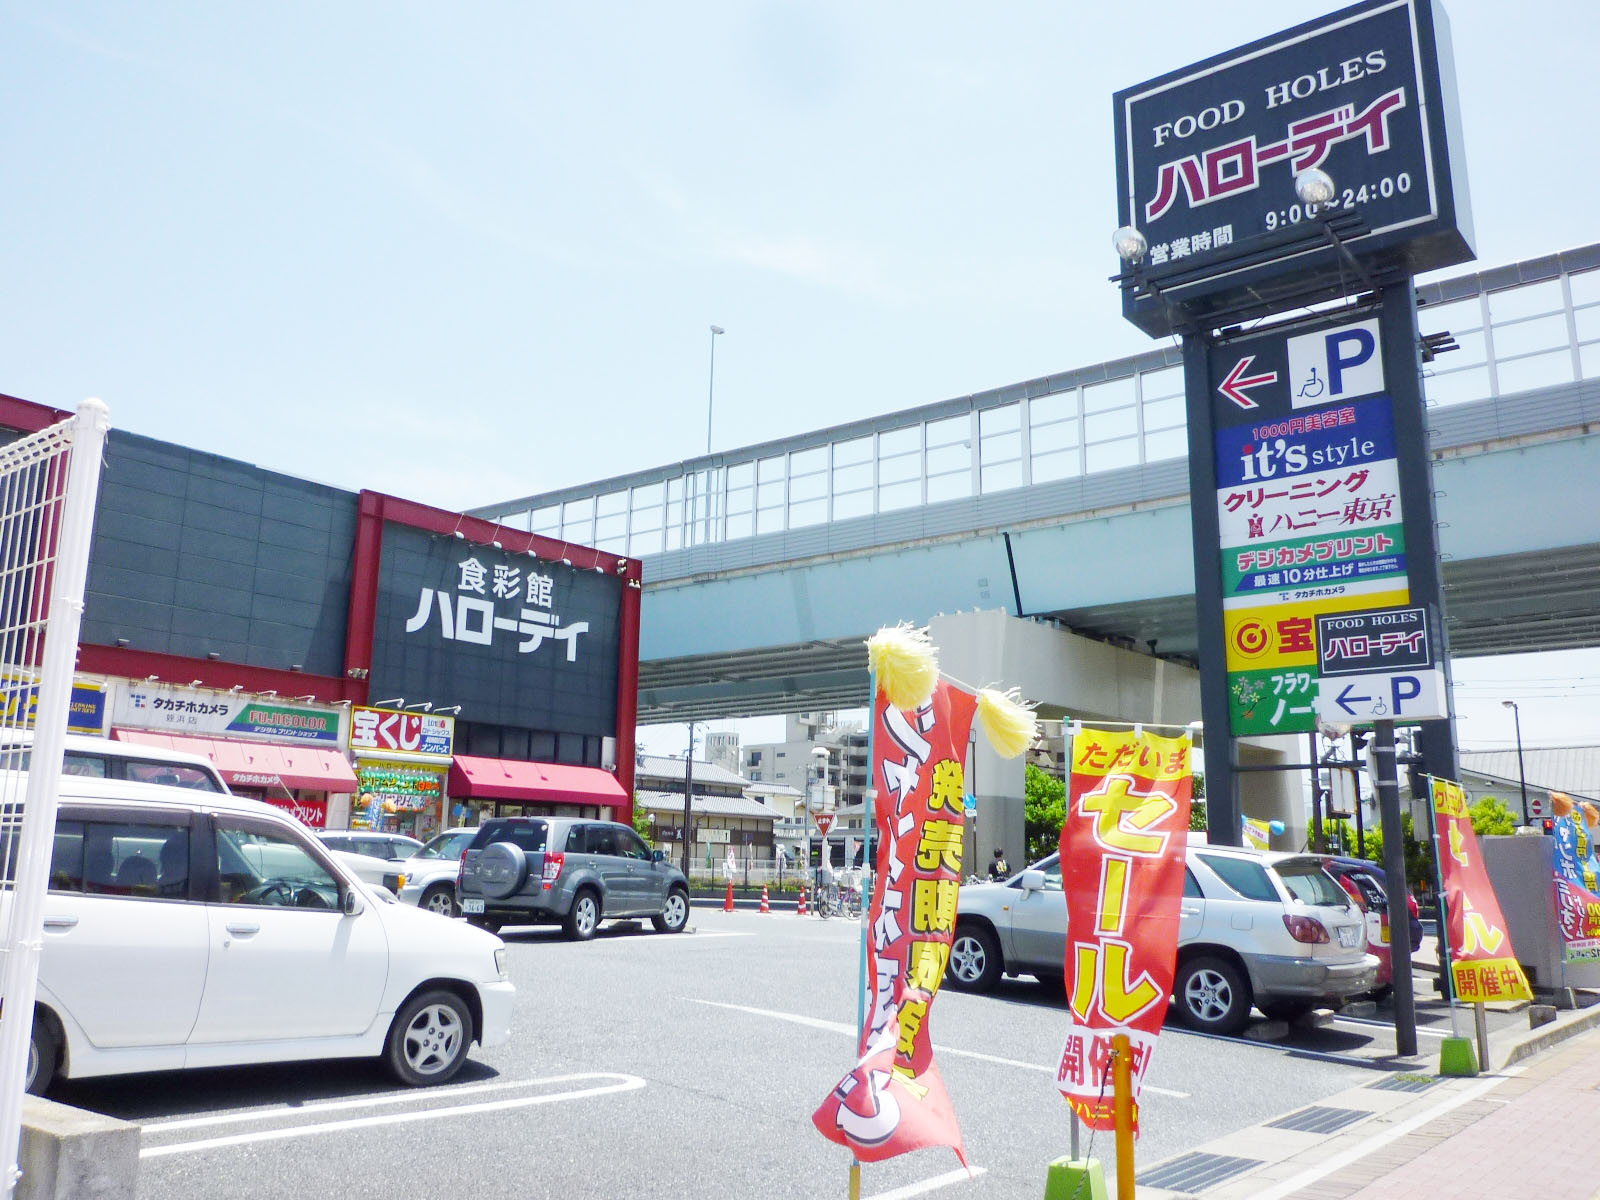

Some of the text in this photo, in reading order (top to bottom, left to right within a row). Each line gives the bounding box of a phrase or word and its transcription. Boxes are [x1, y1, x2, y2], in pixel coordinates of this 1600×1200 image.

[1153, 50, 1387, 147] FOOD HOLES
[1150, 225, 1233, 265] 営業時間
[1325, 328, 1375, 396] P
[1252, 407, 1356, 440] 1000円美容室
[1312, 438, 1375, 466] style
[1224, 469, 1370, 512] クリーニング
[1269, 493, 1396, 533] ハニー東京
[1237, 533, 1393, 571] デジカメプリント
[457, 557, 553, 608] 食彩館
[1295, 586, 1345, 599] タカチホカメラ
[1277, 617, 1314, 653] 宝
[1327, 613, 1418, 631] FOOD HOLES
[153, 698, 229, 716] タカチホカメラ
[1391, 676, 1421, 715] P
[249, 710, 327, 730] FUJICOLOR
[352, 710, 420, 750] 宝くじ
[421, 744, 449, 754] ナンバーズ
[1078, 741, 1187, 775] ただいま
[233, 773, 281, 785] タカチホカメラ
[1071, 774, 1178, 1026] セール
